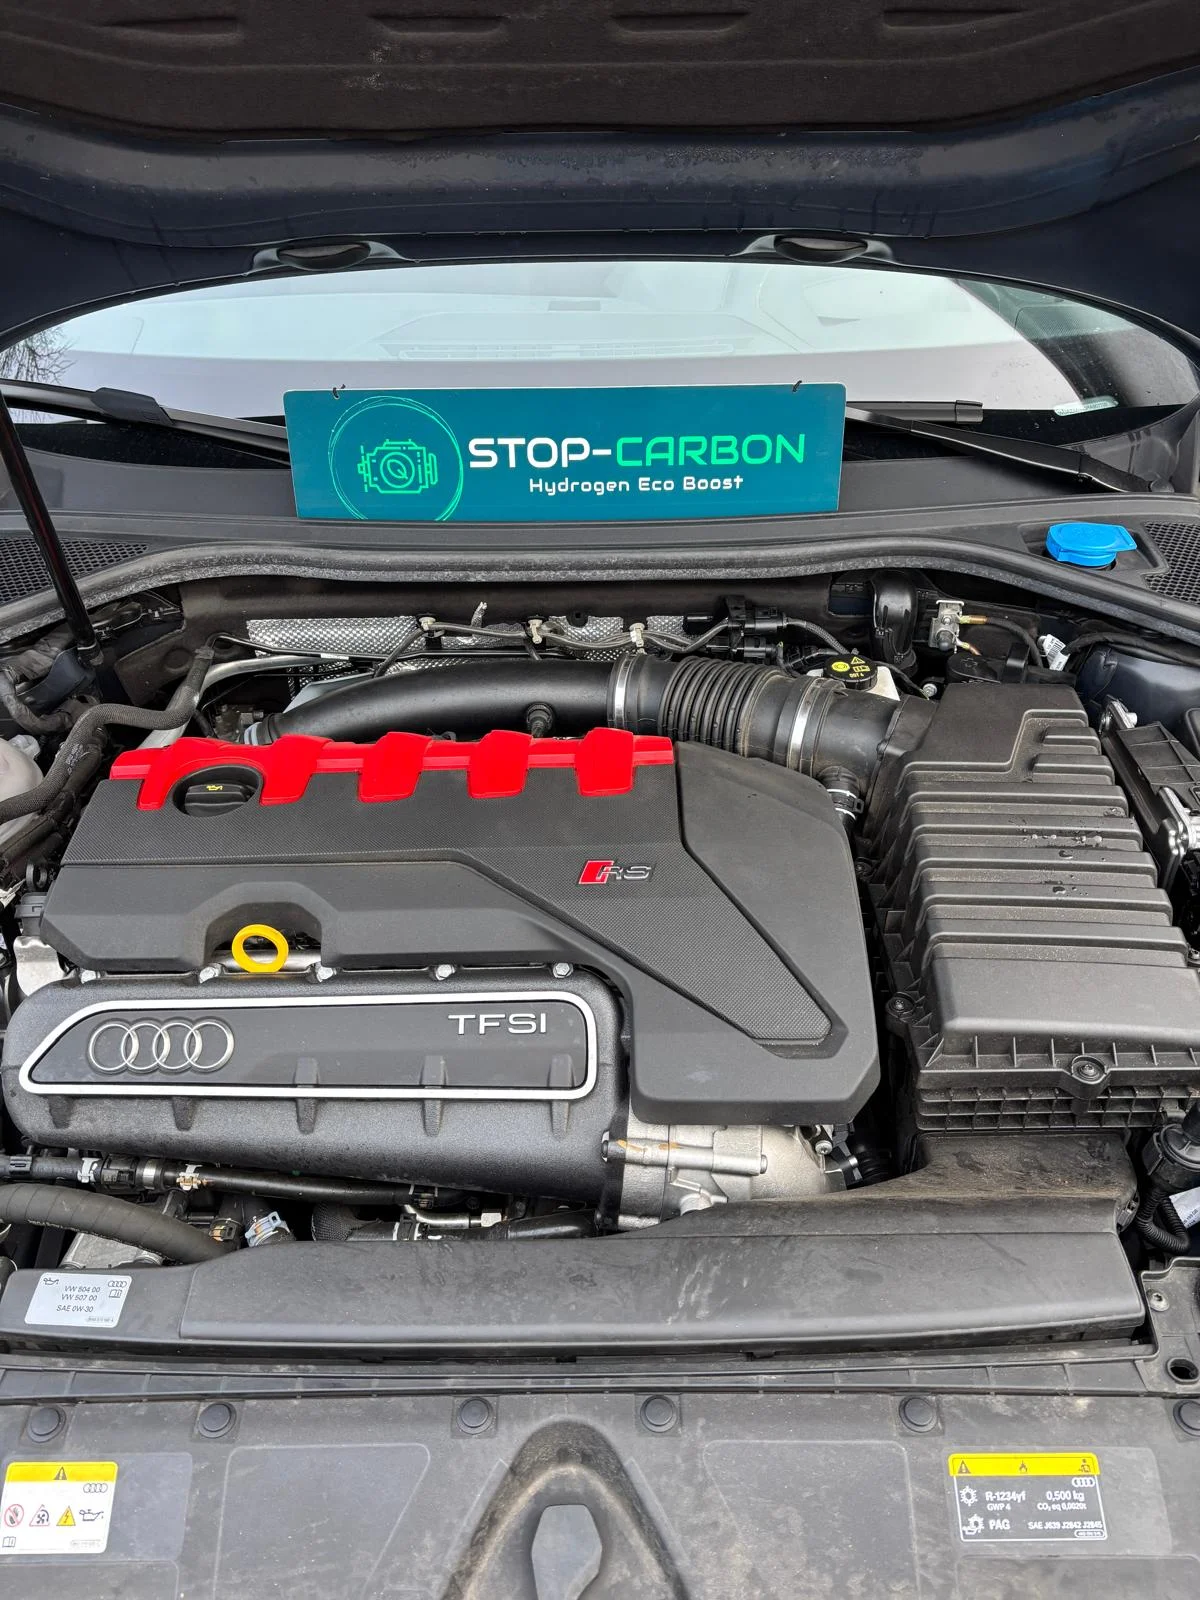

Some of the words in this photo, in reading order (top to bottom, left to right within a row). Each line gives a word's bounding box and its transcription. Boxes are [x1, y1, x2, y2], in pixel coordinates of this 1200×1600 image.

[468, 433, 806, 468] STOP-CARBON
[529, 477, 630, 496] Hydrogen
[638, 477, 675, 491] Eco
[683, 475, 744, 490] Boost
[592, 864, 652, 881] RS
[448, 1013, 547, 1035] TFSI
[64, 1285, 78, 1293] VW
[61, 1293, 75, 1301] VW
[56, 1304, 72, 1312] SAE
[71, 1305, 94, 1313] 0W-30
[985, 1491, 1026, 1503] R-1234yf
[1046, 1490, 1072, 1501] 0,500
[1072, 1490, 1085, 1502] kg
[987, 1503, 1005, 1511] GWP
[1051, 1503, 1061, 1511] eq
[989, 1519, 1011, 1530] PAG
[1028, 1521, 1043, 1530] SAE
